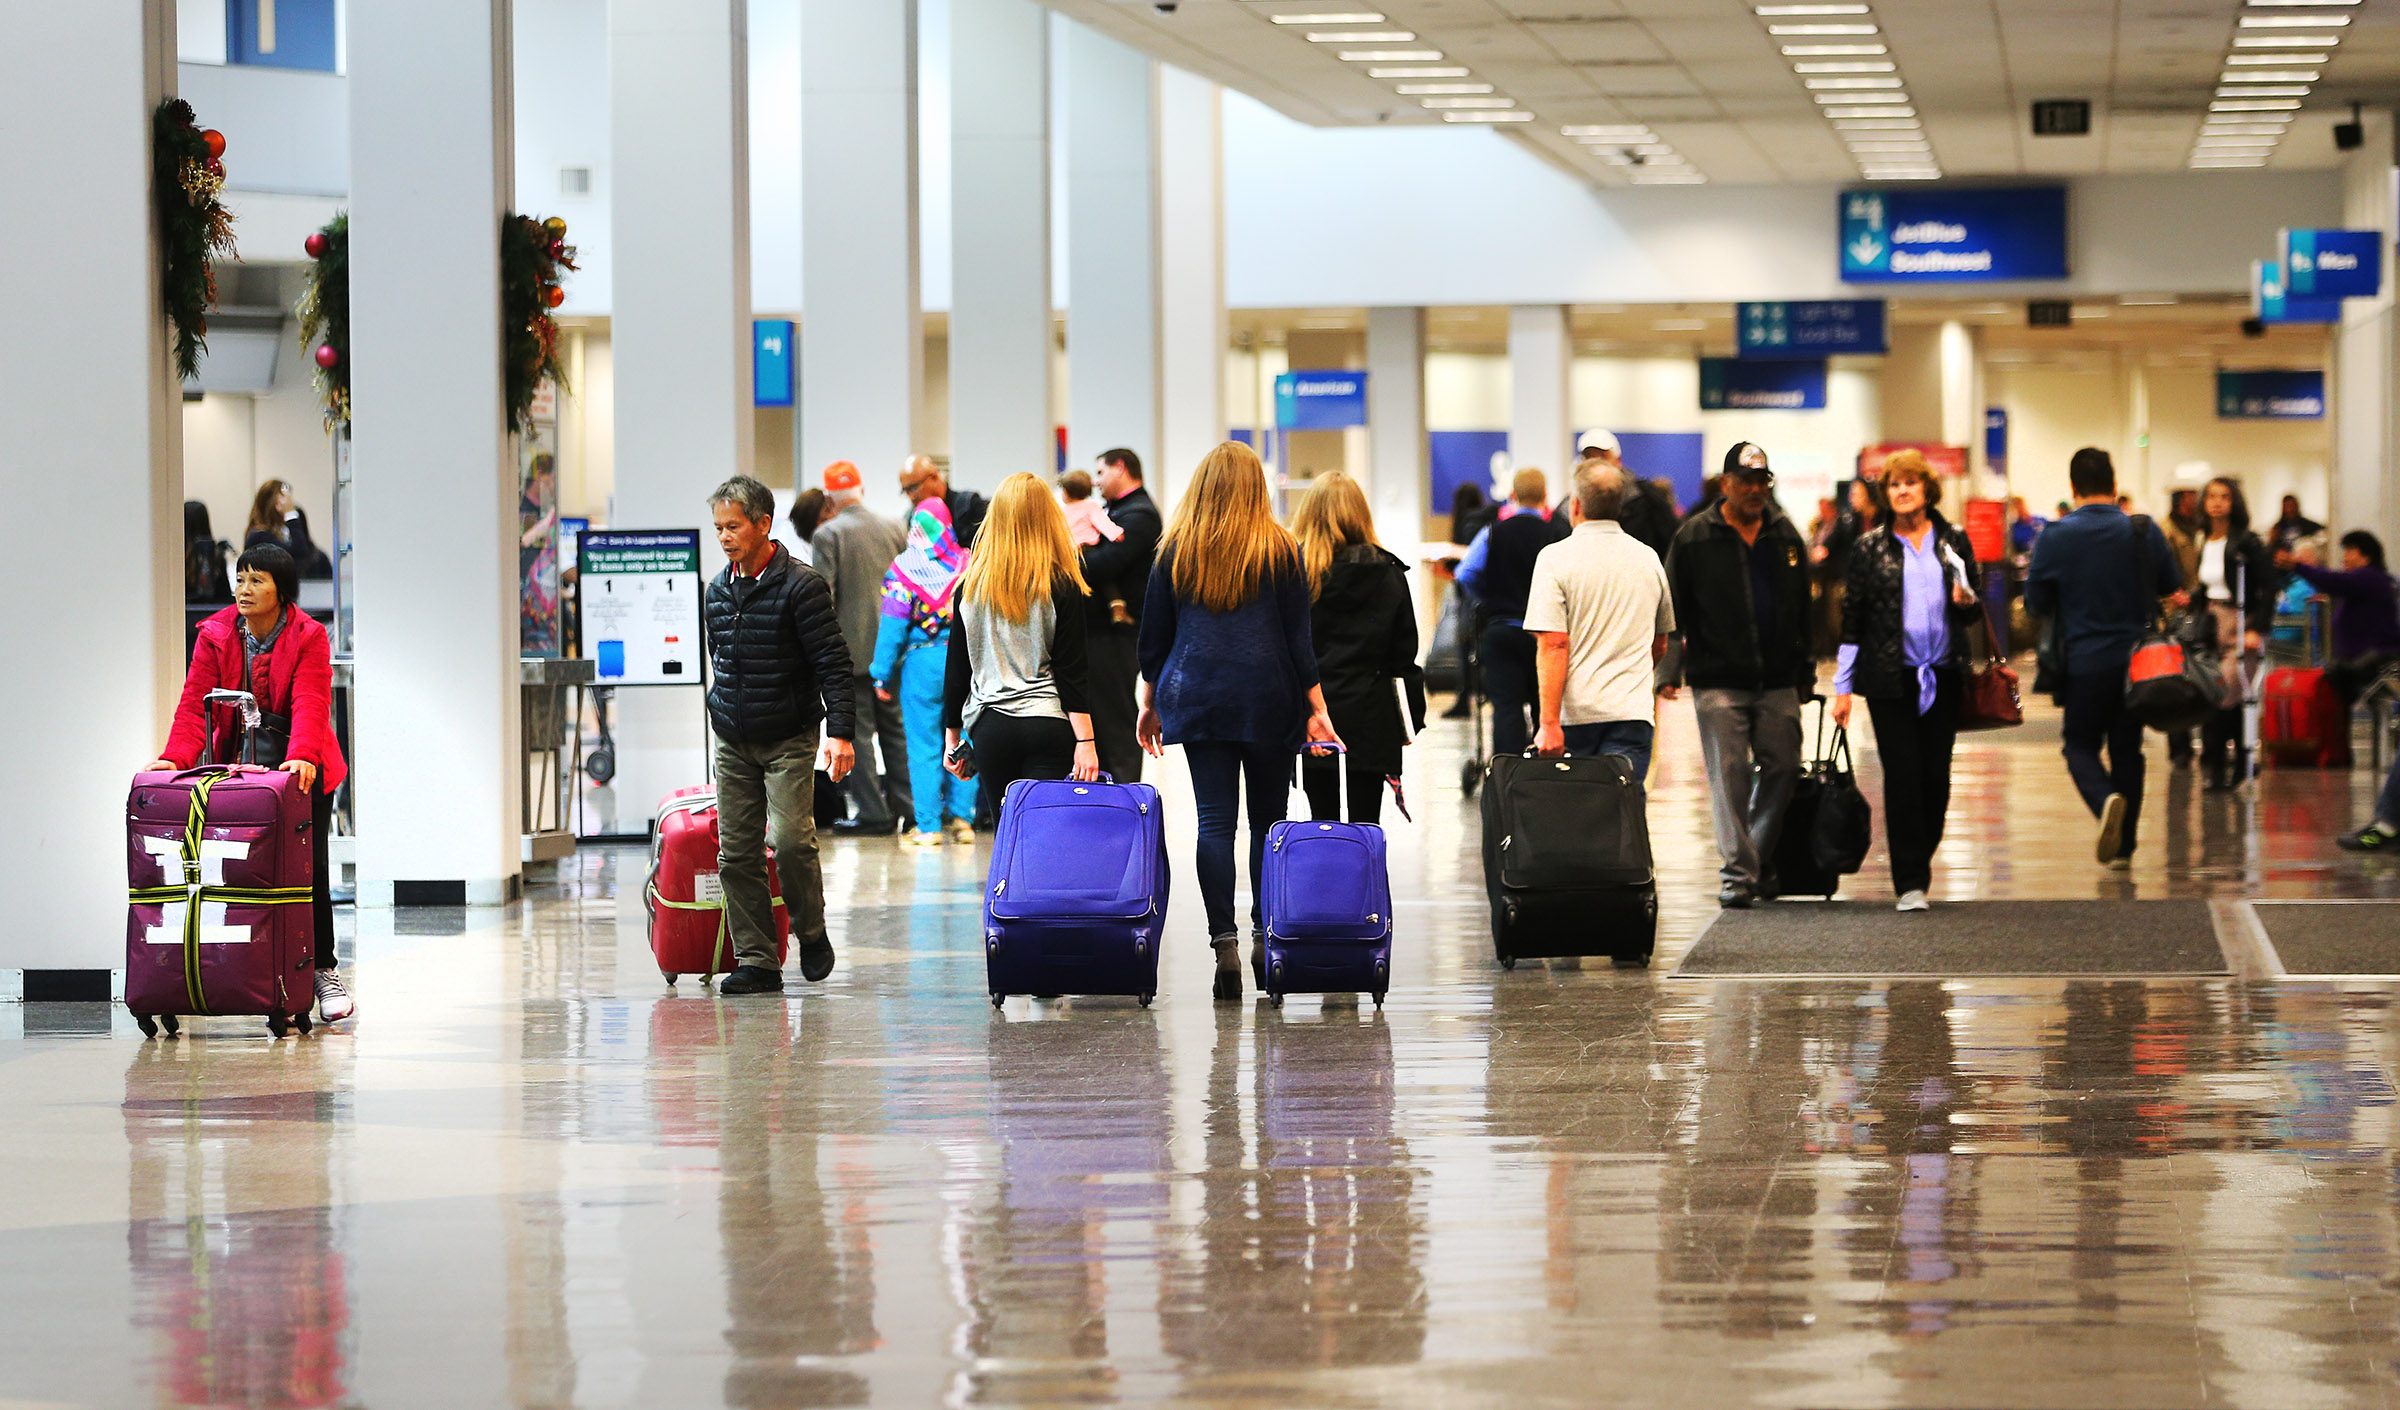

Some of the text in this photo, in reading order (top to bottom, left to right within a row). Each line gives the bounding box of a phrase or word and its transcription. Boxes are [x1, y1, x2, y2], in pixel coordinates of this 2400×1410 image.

[1892, 222, 1967, 243] JetBlue
[1891, 250, 1992, 272] Southwest
[2317, 252, 2358, 270] Men
[587, 551, 690, 561] You are allowed to carry
[606, 579, 612, 592] 1
[667, 578, 673, 591] 1
